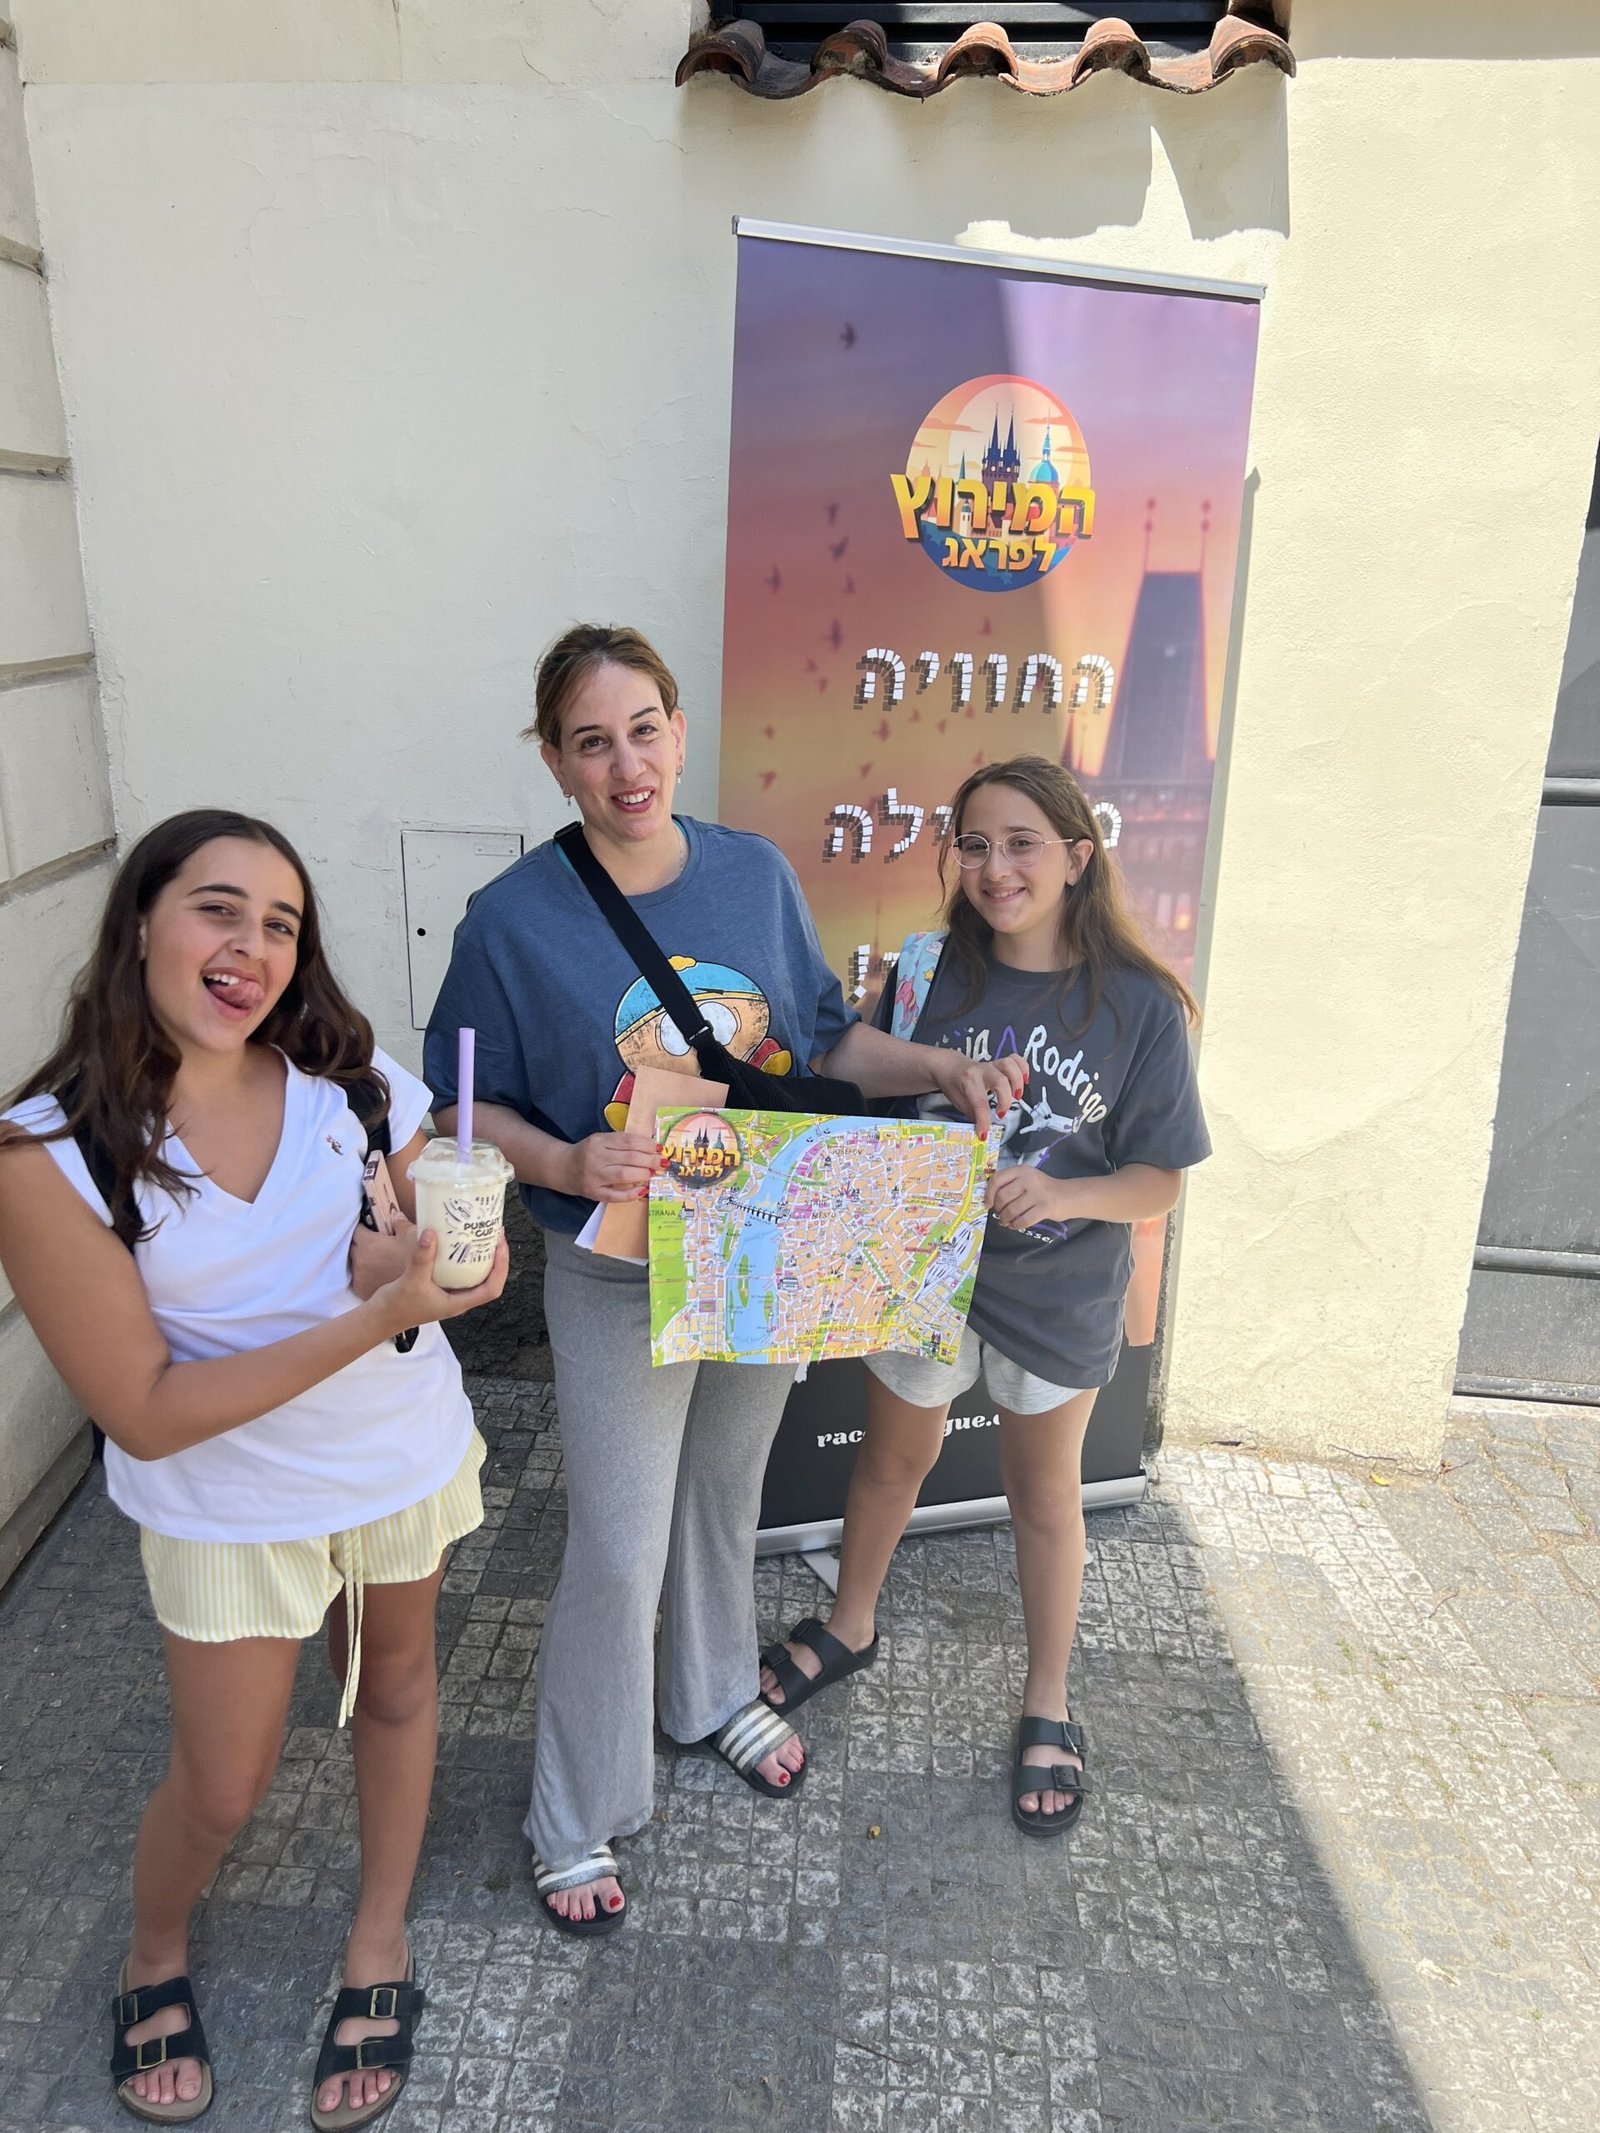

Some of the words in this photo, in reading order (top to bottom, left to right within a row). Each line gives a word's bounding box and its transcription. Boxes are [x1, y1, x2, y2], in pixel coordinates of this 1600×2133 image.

[889, 473, 1096, 541] המירוץ
[941, 534, 1057, 573] לפראג
[854, 648, 1115, 713] החוויה
[1023, 1024, 1108, 1134] Rodrigo
[677, 1164, 724, 1178] לפראג
[475, 1227, 494, 1238] CUP
